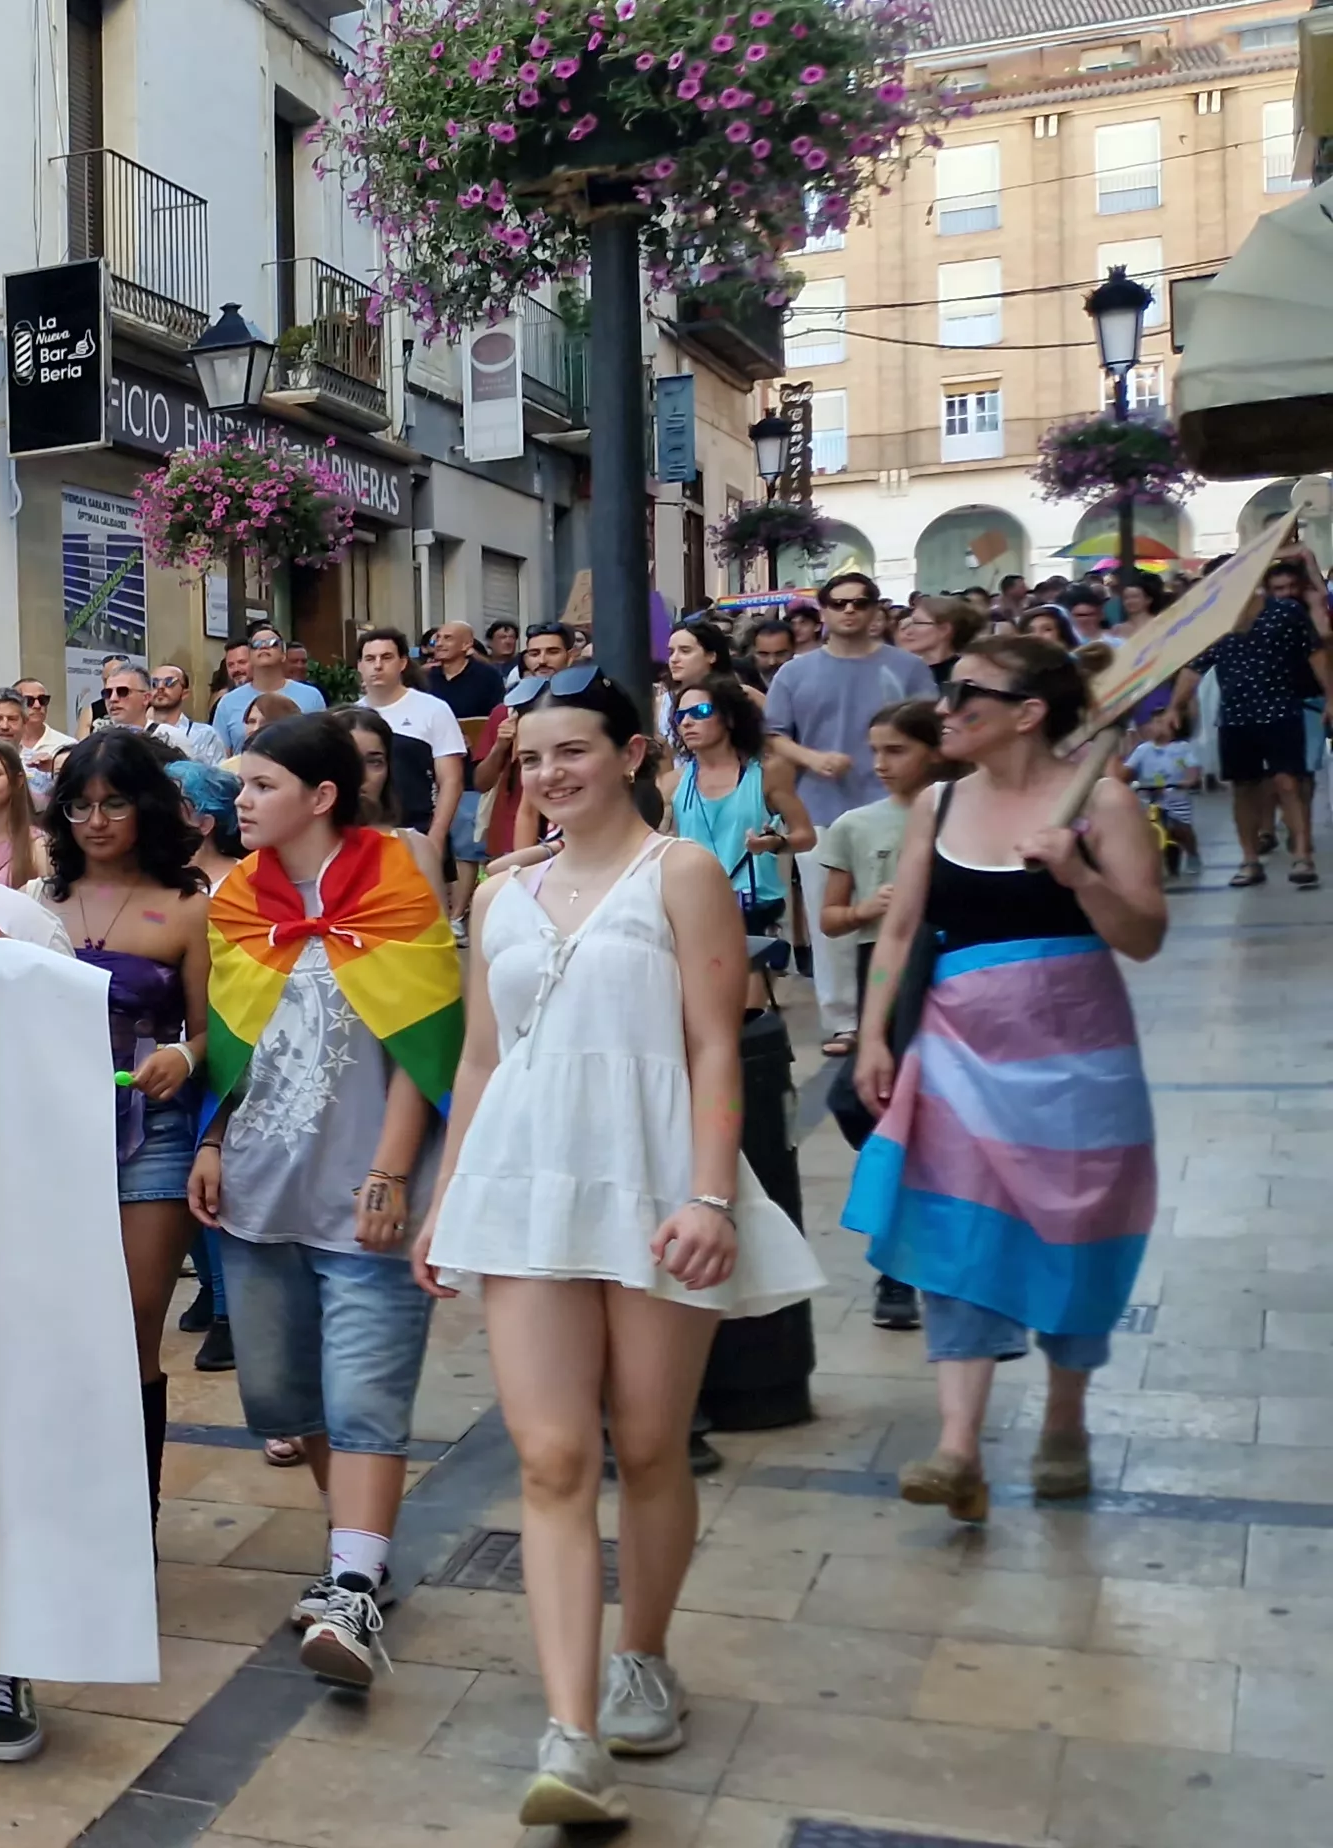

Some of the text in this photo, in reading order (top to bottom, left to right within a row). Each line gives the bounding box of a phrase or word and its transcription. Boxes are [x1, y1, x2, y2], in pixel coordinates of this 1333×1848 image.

[39, 315, 57, 331] La
[35, 330, 71, 345] Nueva
[40, 348, 68, 363] Bar
